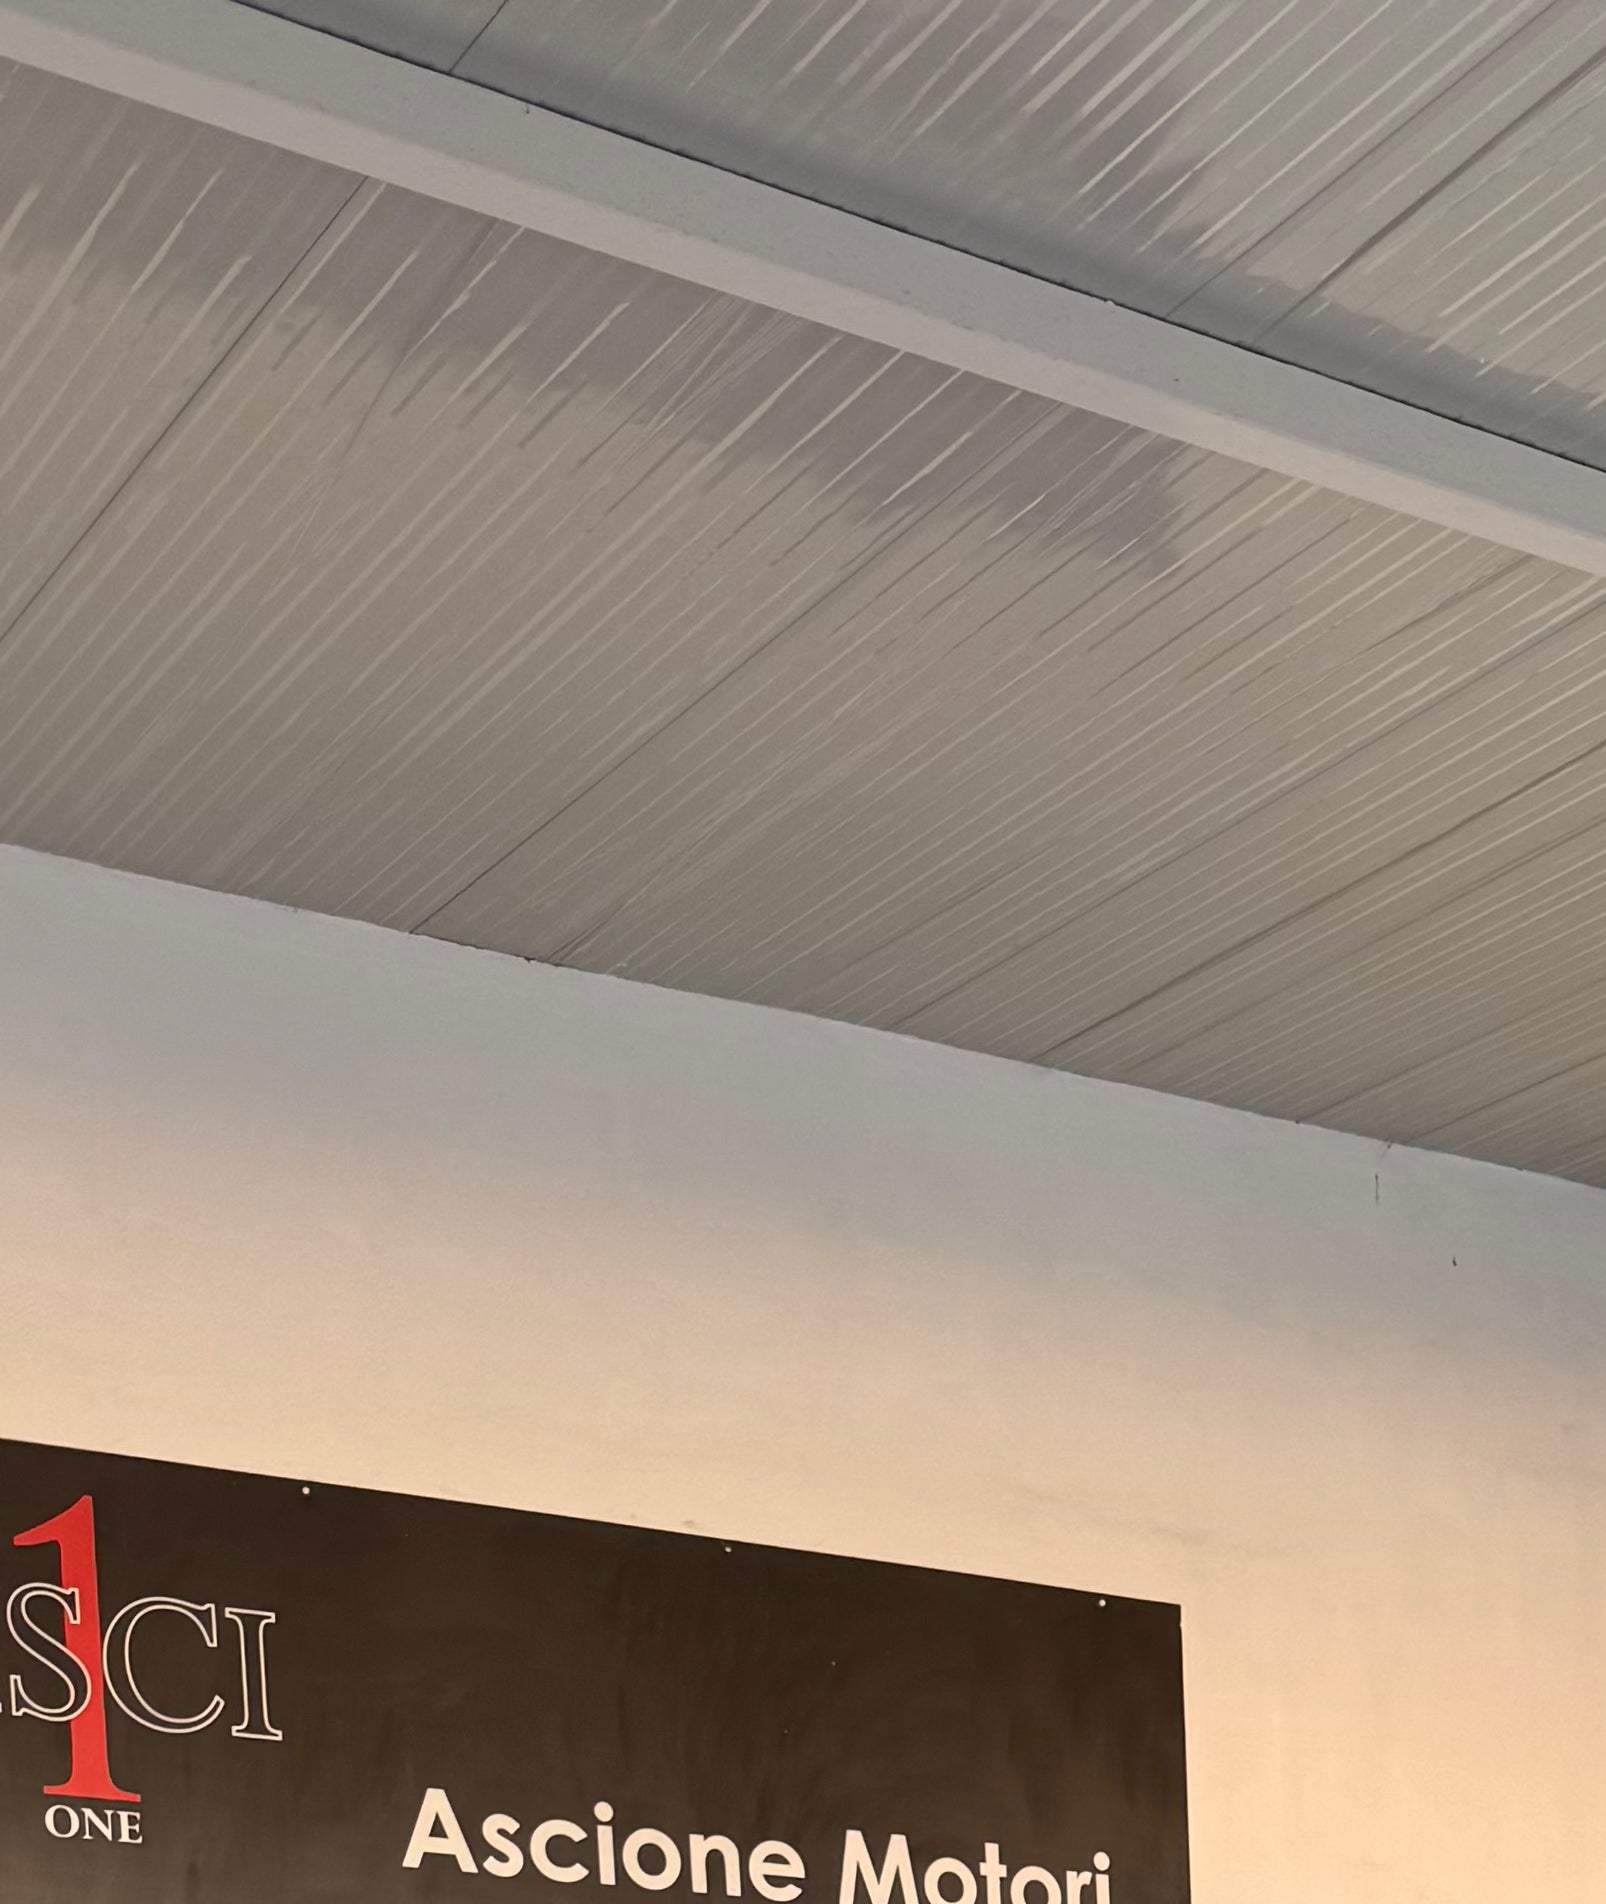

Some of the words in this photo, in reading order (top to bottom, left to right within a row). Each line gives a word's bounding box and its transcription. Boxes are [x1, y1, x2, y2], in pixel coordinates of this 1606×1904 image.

[0, 1582, 283, 1741] SCI
[44, 1804, 143, 1844] ONE
[402, 1787, 806, 1904] Ascione
